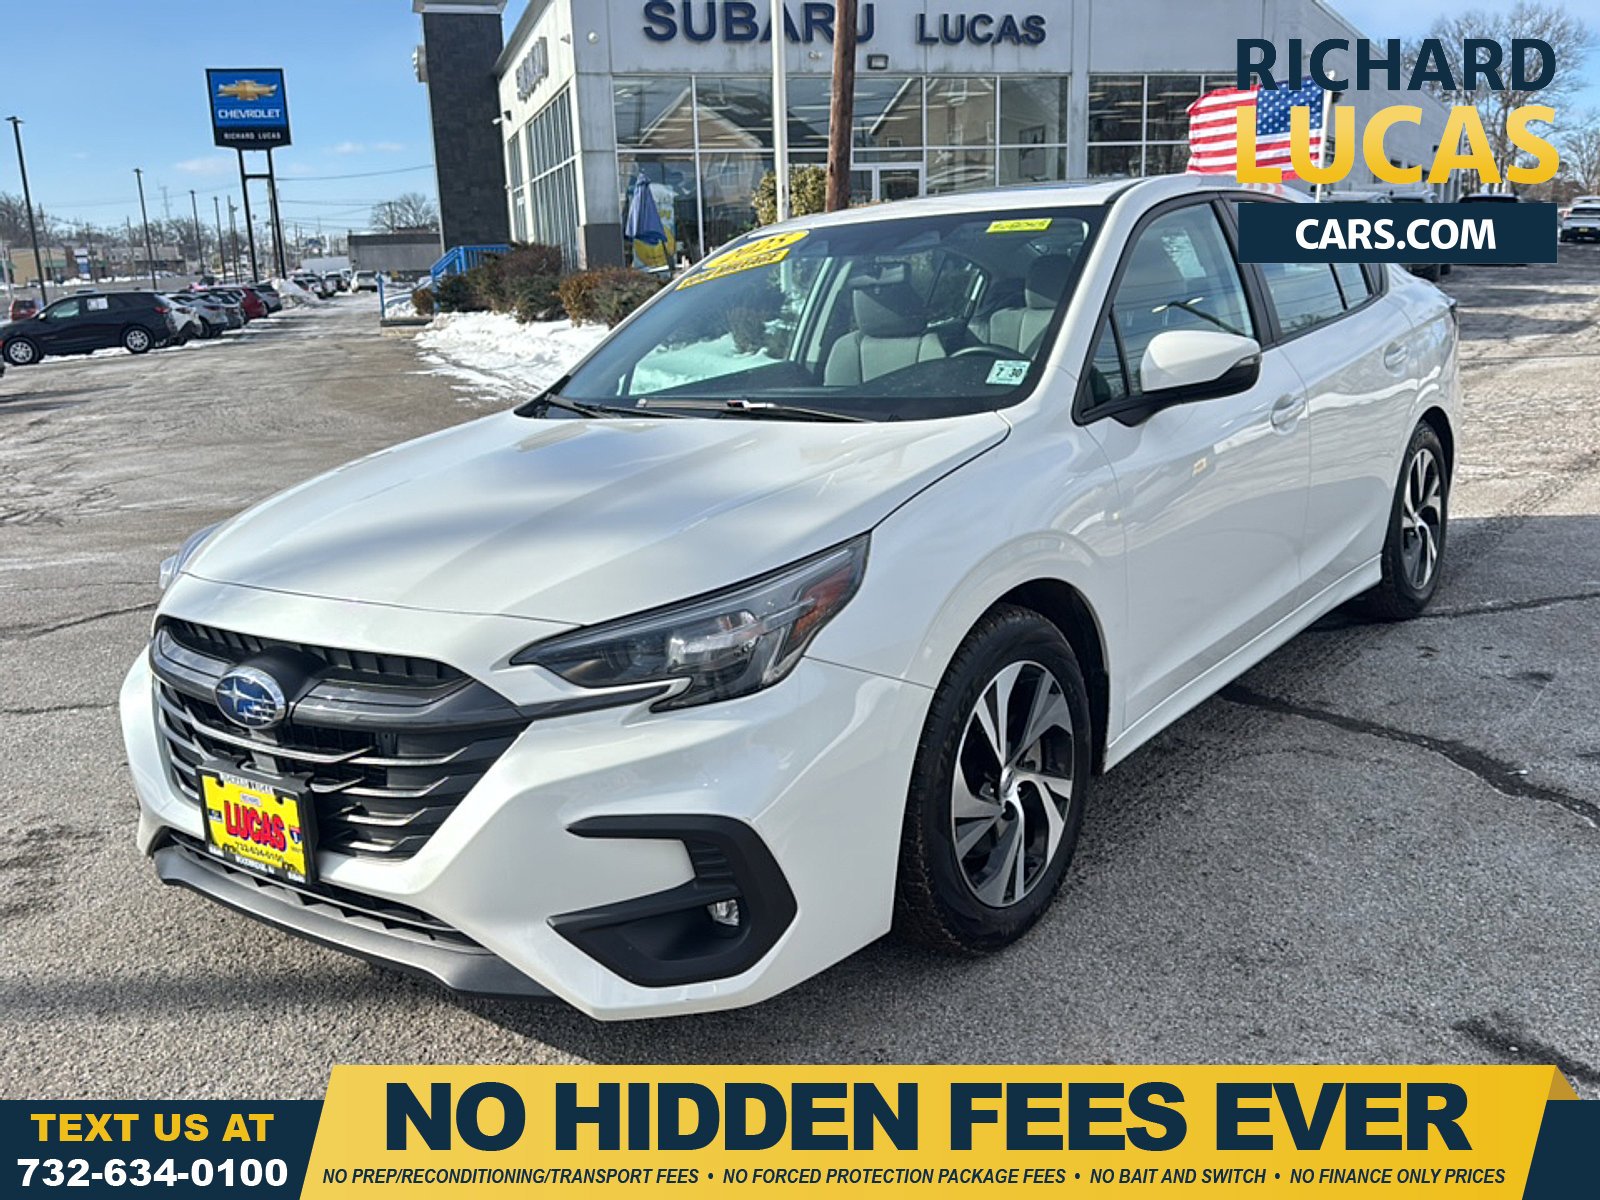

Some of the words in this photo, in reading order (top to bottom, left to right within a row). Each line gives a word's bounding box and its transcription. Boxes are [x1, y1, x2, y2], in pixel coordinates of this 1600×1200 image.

[643, 0, 875, 42] SUBARU
[916, 13, 1047, 45] LUCAS
[218, 108, 281, 119] CHEVROLET
[223, 132, 255, 140] RICHARD
[258, 132, 281, 140] LUCAS
[223, 800, 287, 852] LUCAS
